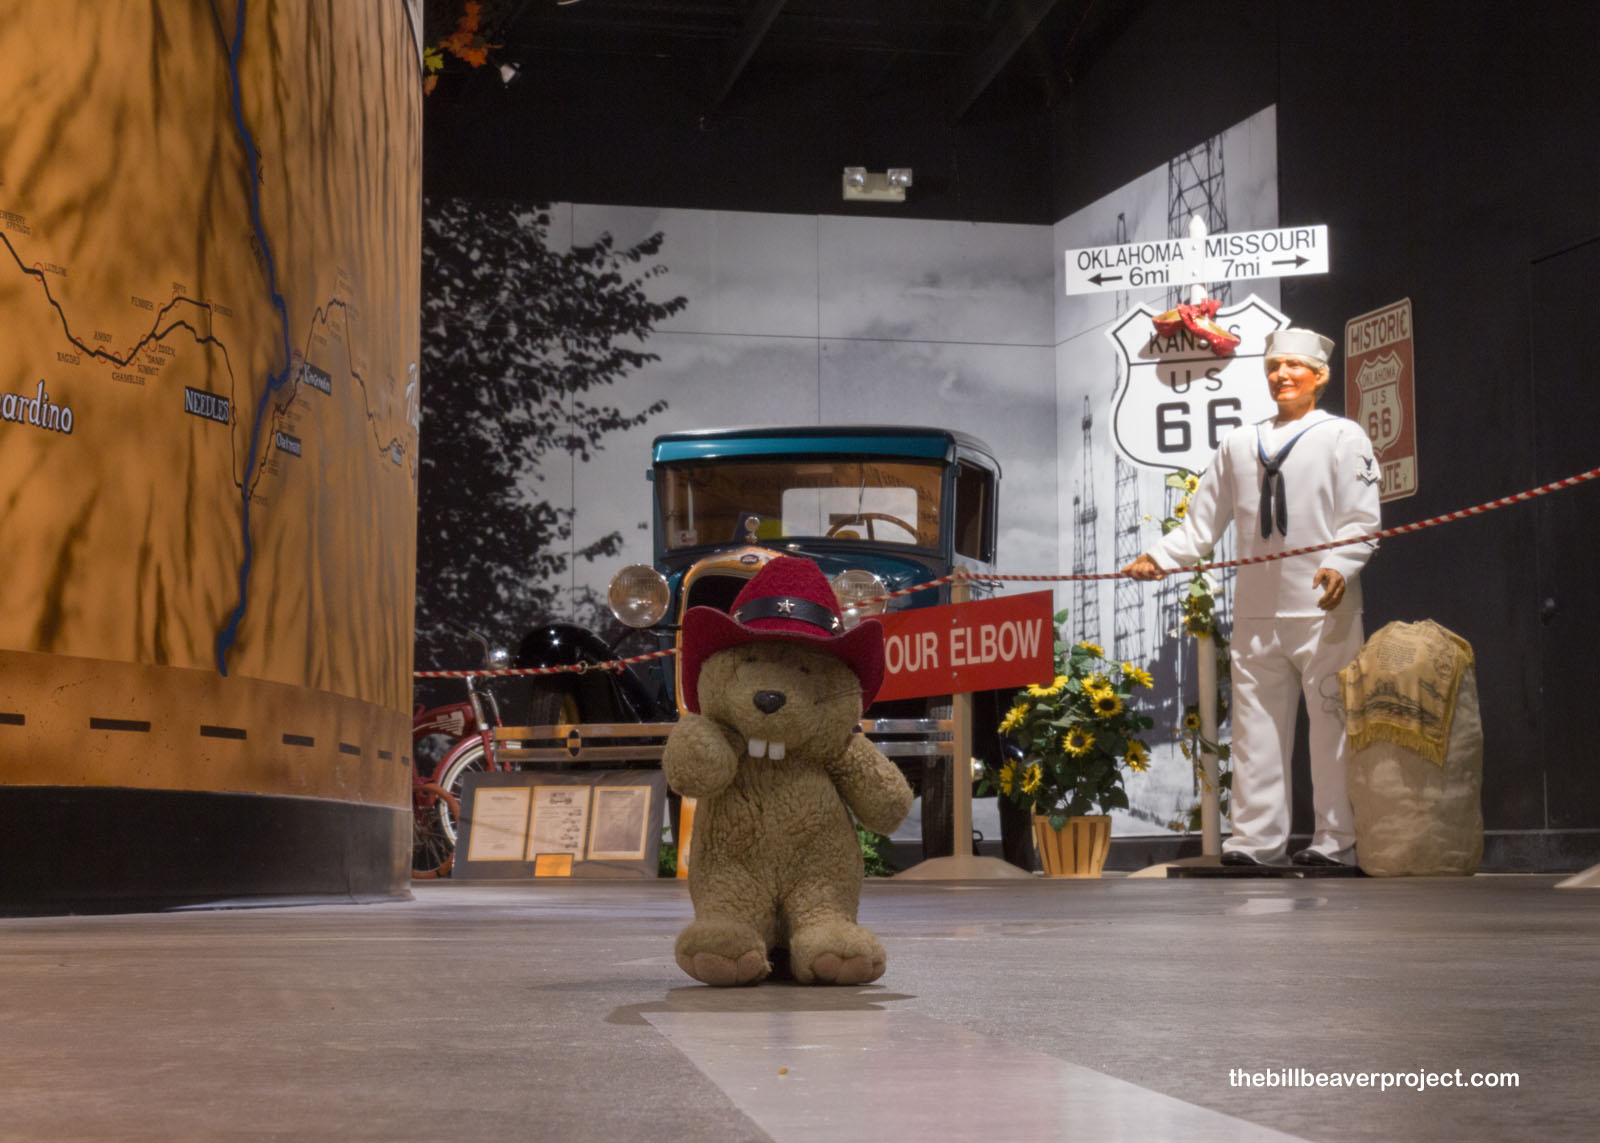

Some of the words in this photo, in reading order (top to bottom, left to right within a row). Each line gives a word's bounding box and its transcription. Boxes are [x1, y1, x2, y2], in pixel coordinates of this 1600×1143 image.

[1077, 242, 1184, 271] OKLAHOMA
[1205, 229, 1316, 258] MISSOURI
[1129, 265, 1170, 286] 6mi
[1222, 257, 1260, 278] 7mi
[1149, 323, 1242, 354] KANSS
[1351, 309, 1408, 354] HISTORIC
[1361, 367, 1396, 388] OKLAHOMA
[0, 379, 73, 433] ardino
[185, 387, 229, 422] NEEDLES
[1156, 397, 1243, 453] 66
[1368, 407, 1392, 441] 66
[883, 632, 939, 674] OUR
[951, 619, 1043, 666] ELBOW
